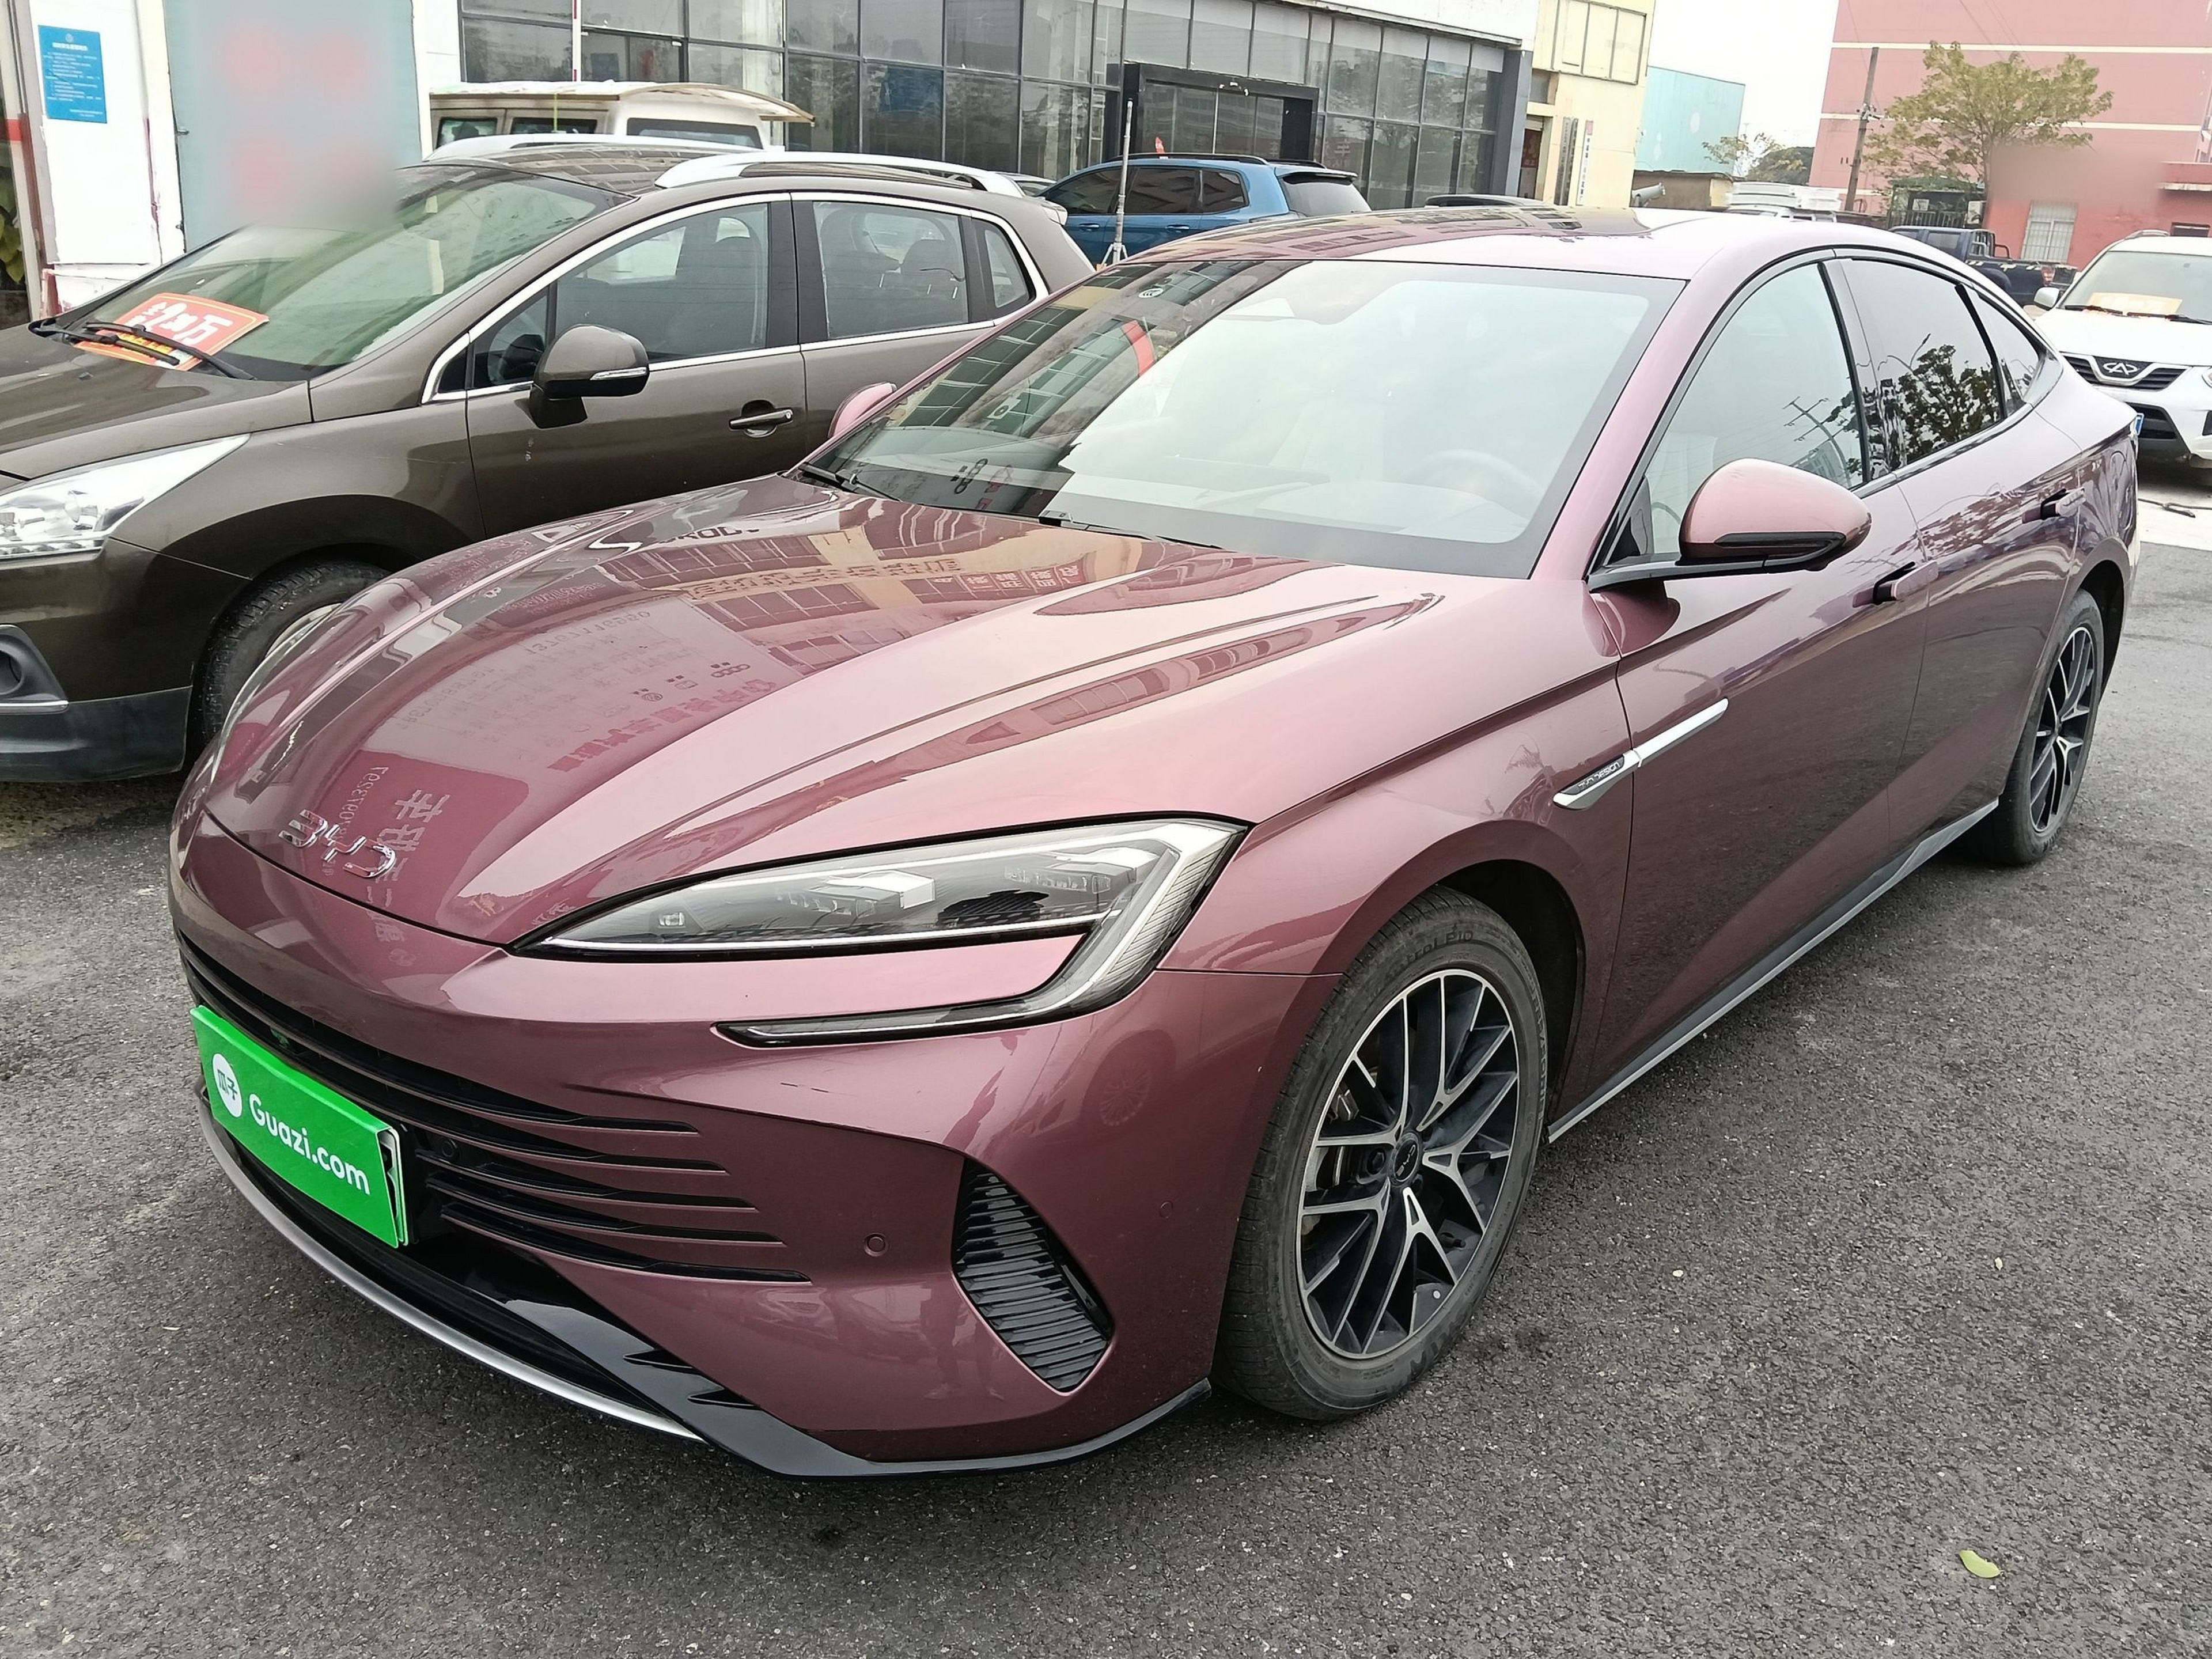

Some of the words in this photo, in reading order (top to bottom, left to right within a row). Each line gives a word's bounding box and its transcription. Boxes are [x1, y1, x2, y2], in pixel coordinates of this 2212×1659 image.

[1594, 762, 1620, 779] DESIGN
[278, 809, 396, 878] BYD
[217, 1069, 238, 1100] 瓜子
[248, 1093, 371, 1195] Guazi.com
[1396, 1144, 1416, 1176] BYD
